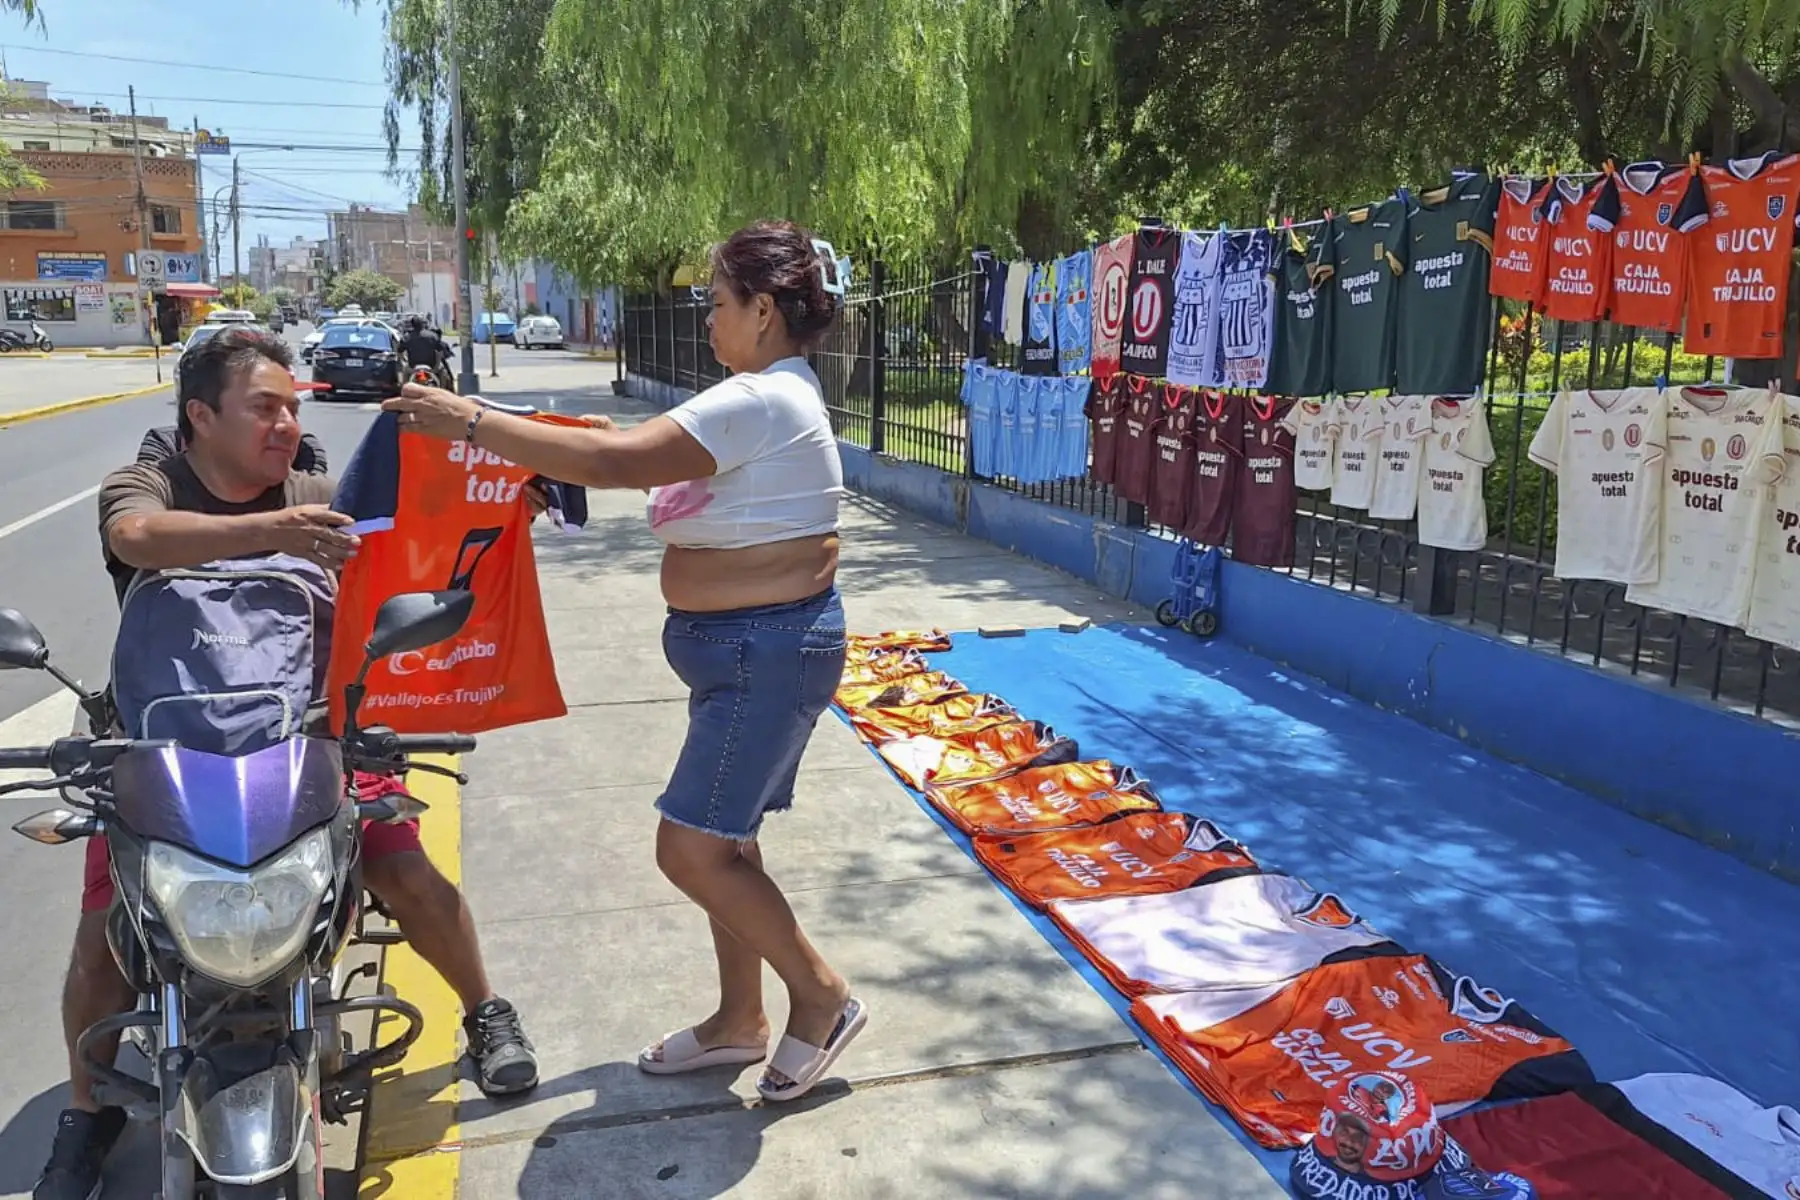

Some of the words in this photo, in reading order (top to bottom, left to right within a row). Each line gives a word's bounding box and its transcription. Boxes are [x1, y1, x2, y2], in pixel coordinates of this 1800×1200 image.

[1633, 229, 1669, 253] UCV
[1732, 227, 1777, 252] UCV
[1415, 251, 1464, 275] apuesta
[1508, 249, 1528, 261] AJA
[1341, 269, 1380, 292] apuesta
[1423, 271, 1452, 290] total
[1624, 263, 1660, 279] CAJA
[1351, 288, 1373, 305] total
[1592, 470, 1634, 484] apuesta
[1671, 469, 1738, 490] apuesta
[465, 474, 522, 504] tota
[1601, 485, 1627, 497] total
[1684, 491, 1723, 512] total
[1776, 508, 1800, 530] ap
[191, 628, 248, 650] Norma
[1110, 852, 1164, 879] UCV
[1290, 1028, 1352, 1072] CAJA
[1340, 1022, 1432, 1069] UCV
